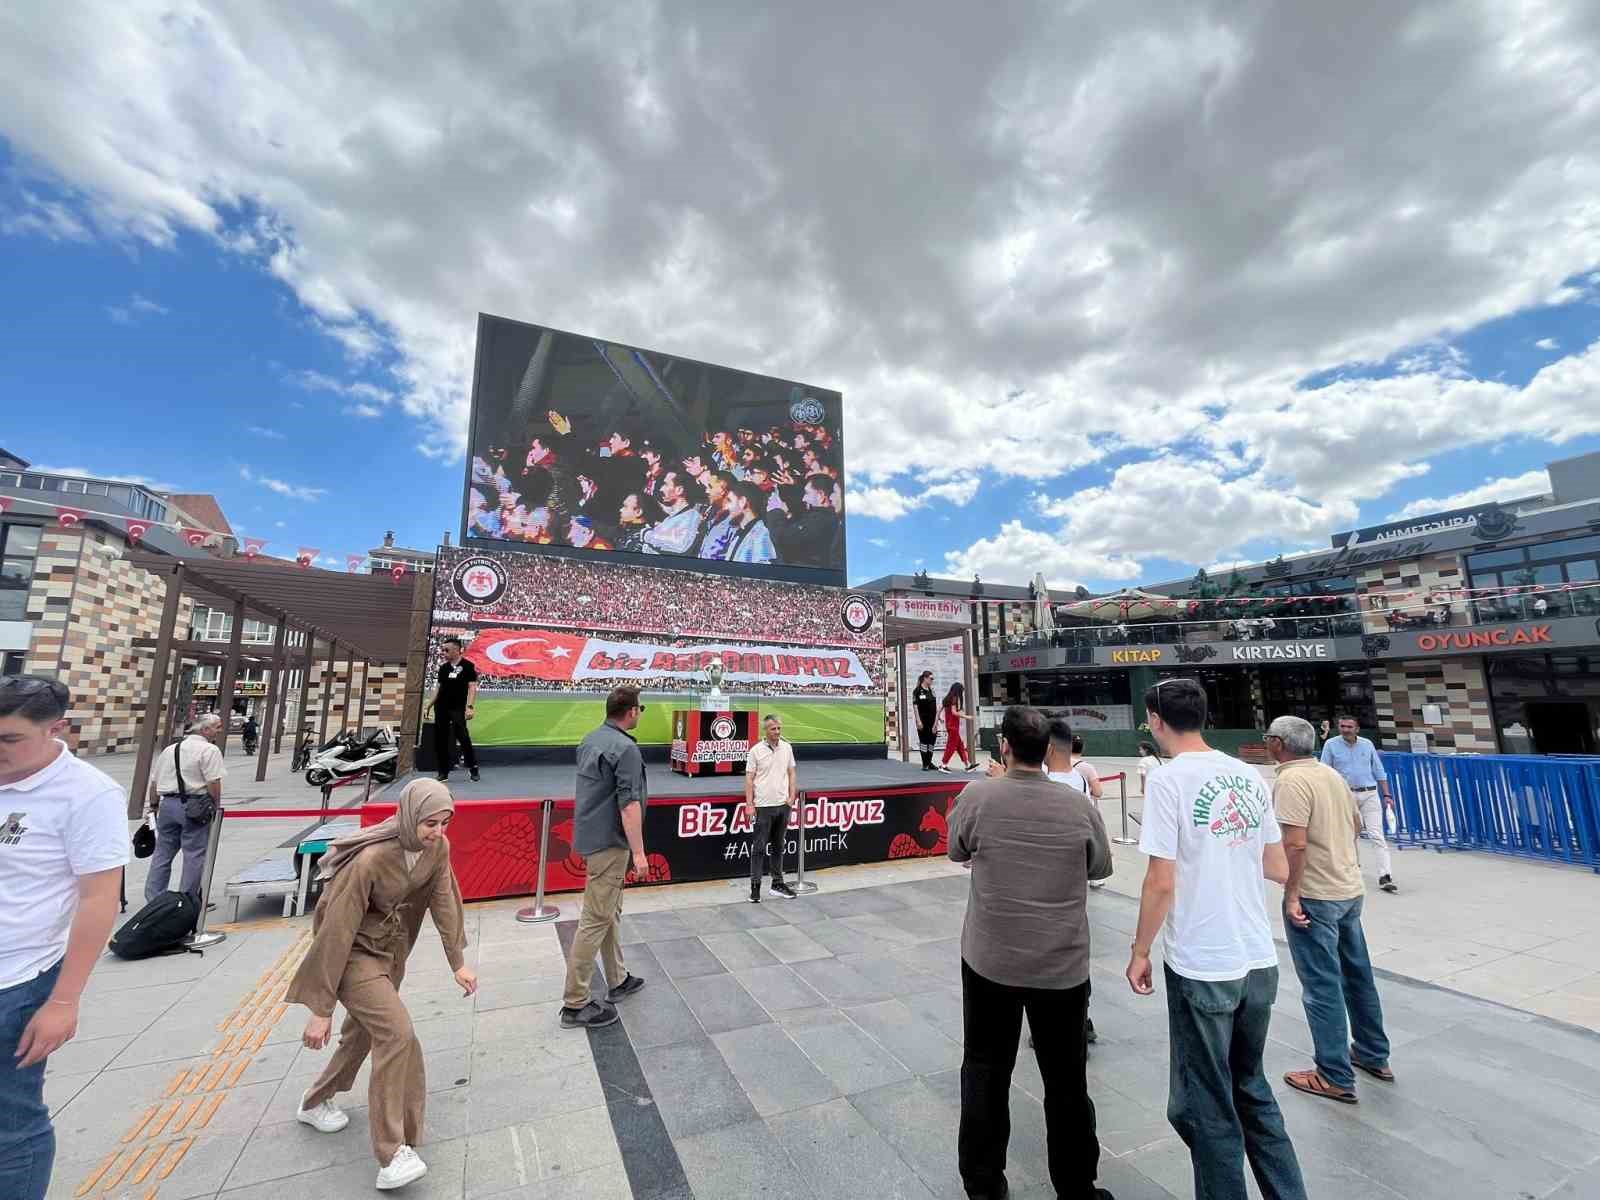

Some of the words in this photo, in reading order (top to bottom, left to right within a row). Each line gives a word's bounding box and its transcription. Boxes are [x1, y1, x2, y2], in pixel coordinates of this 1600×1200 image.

[1232, 642, 1326, 660] KIRTASİYE
[1418, 624, 1552, 651] OYUNCAK
[1112, 647, 1161, 664] KİTAP
[1193, 781, 1220, 827] THREE
[1215, 775, 1252, 793] SLICE
[679, 802, 727, 837] Biz
[730, 797, 885, 833] Adoluyuz
